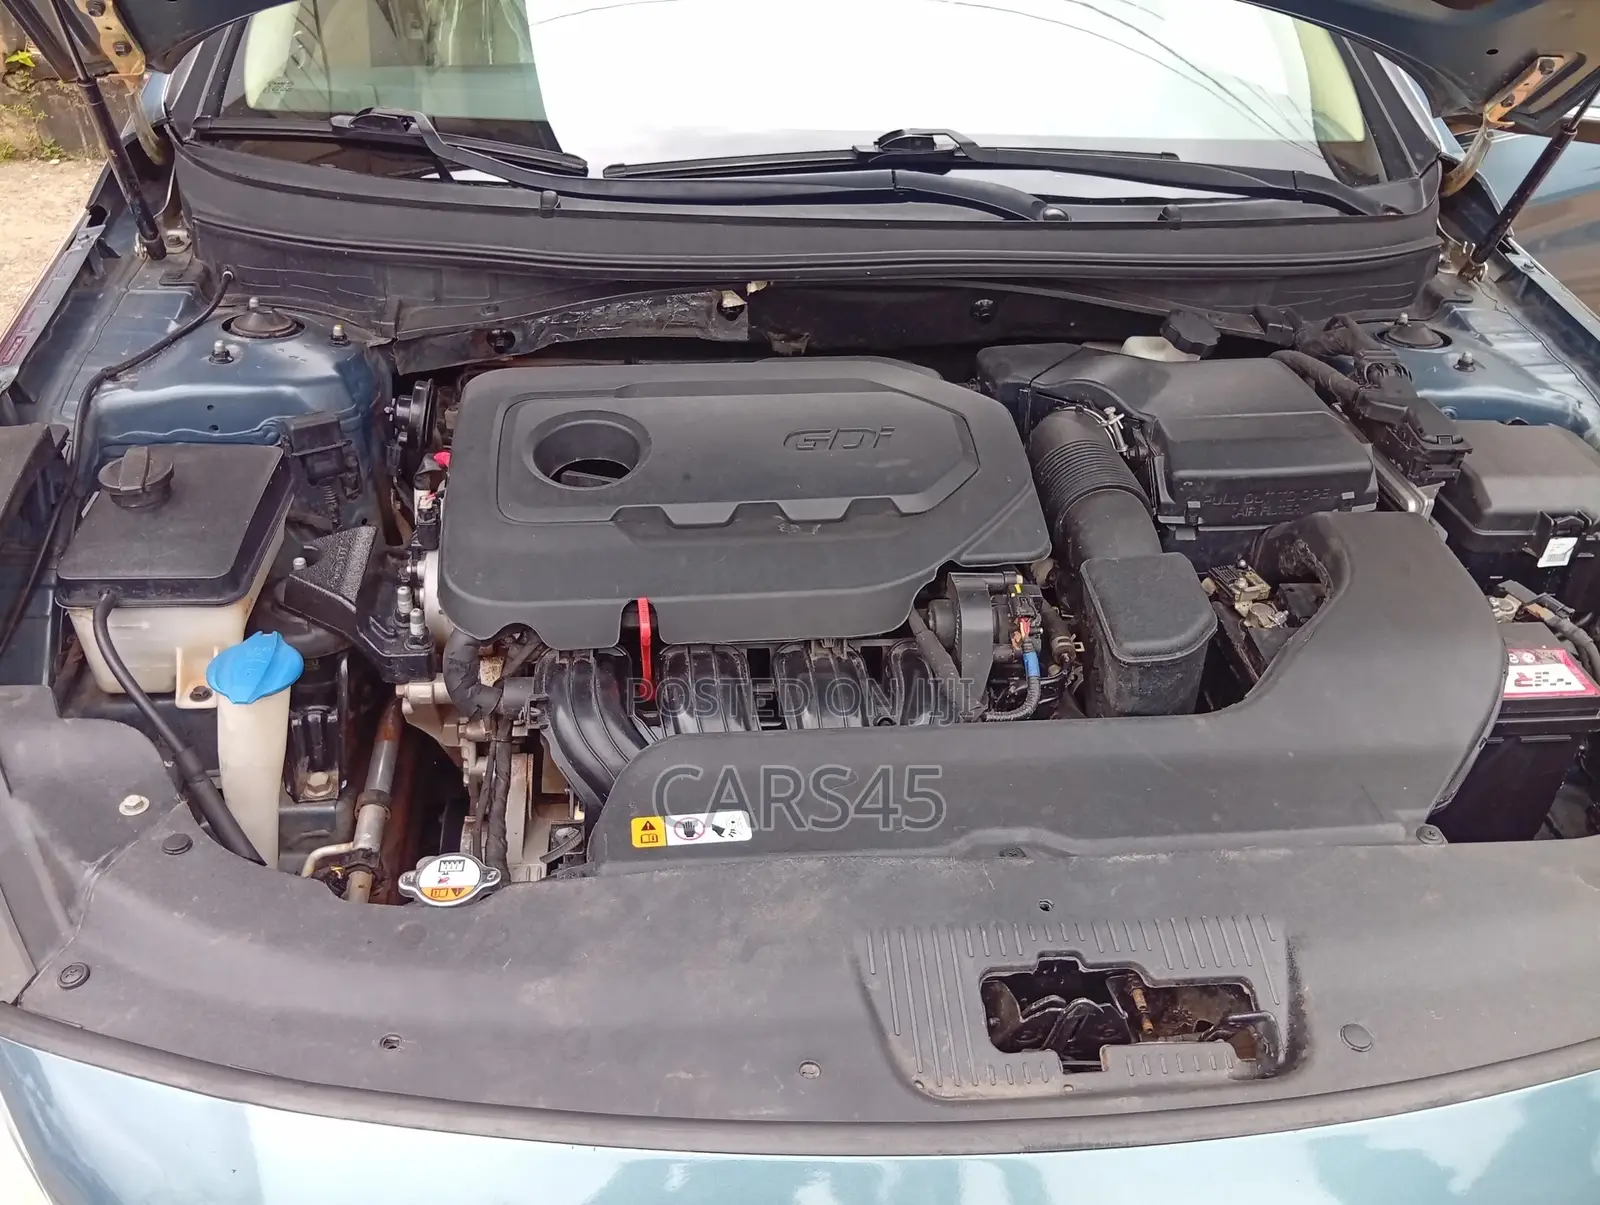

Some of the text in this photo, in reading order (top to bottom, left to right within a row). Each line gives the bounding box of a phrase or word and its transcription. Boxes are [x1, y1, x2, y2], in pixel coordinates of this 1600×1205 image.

[1203, 493, 1239, 506] PULL
[1243, 491, 1275, 505] OUT
[1300, 488, 1338, 501] OPE
